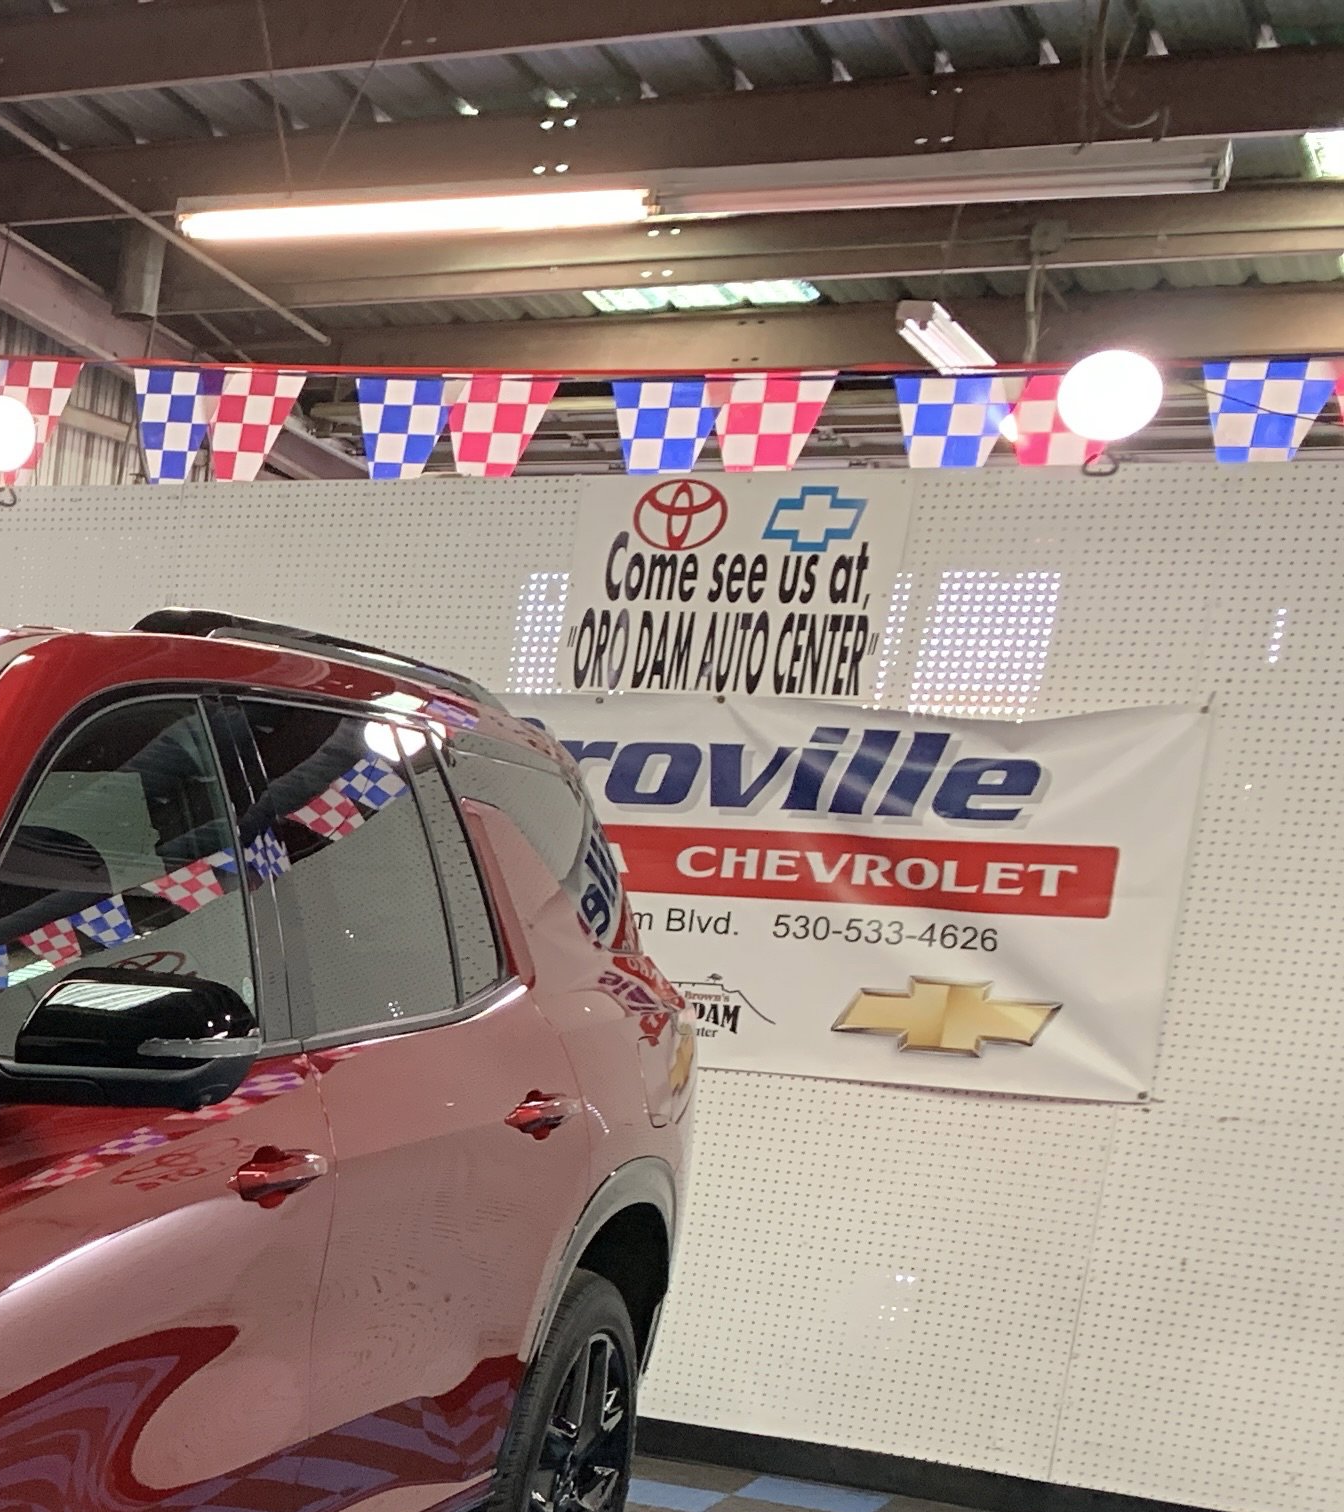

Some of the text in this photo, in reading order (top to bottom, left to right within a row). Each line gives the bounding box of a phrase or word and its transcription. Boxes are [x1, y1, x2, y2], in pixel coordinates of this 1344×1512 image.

[605, 532, 871, 611] Come see us at,
[567, 608, 880, 696] "ORO DAM AUTO CENTER"
[675, 845, 1079, 897] CHEVROLET
[665, 908, 739, 936] Blvd.
[772, 913, 998, 952] 530-533-4626
